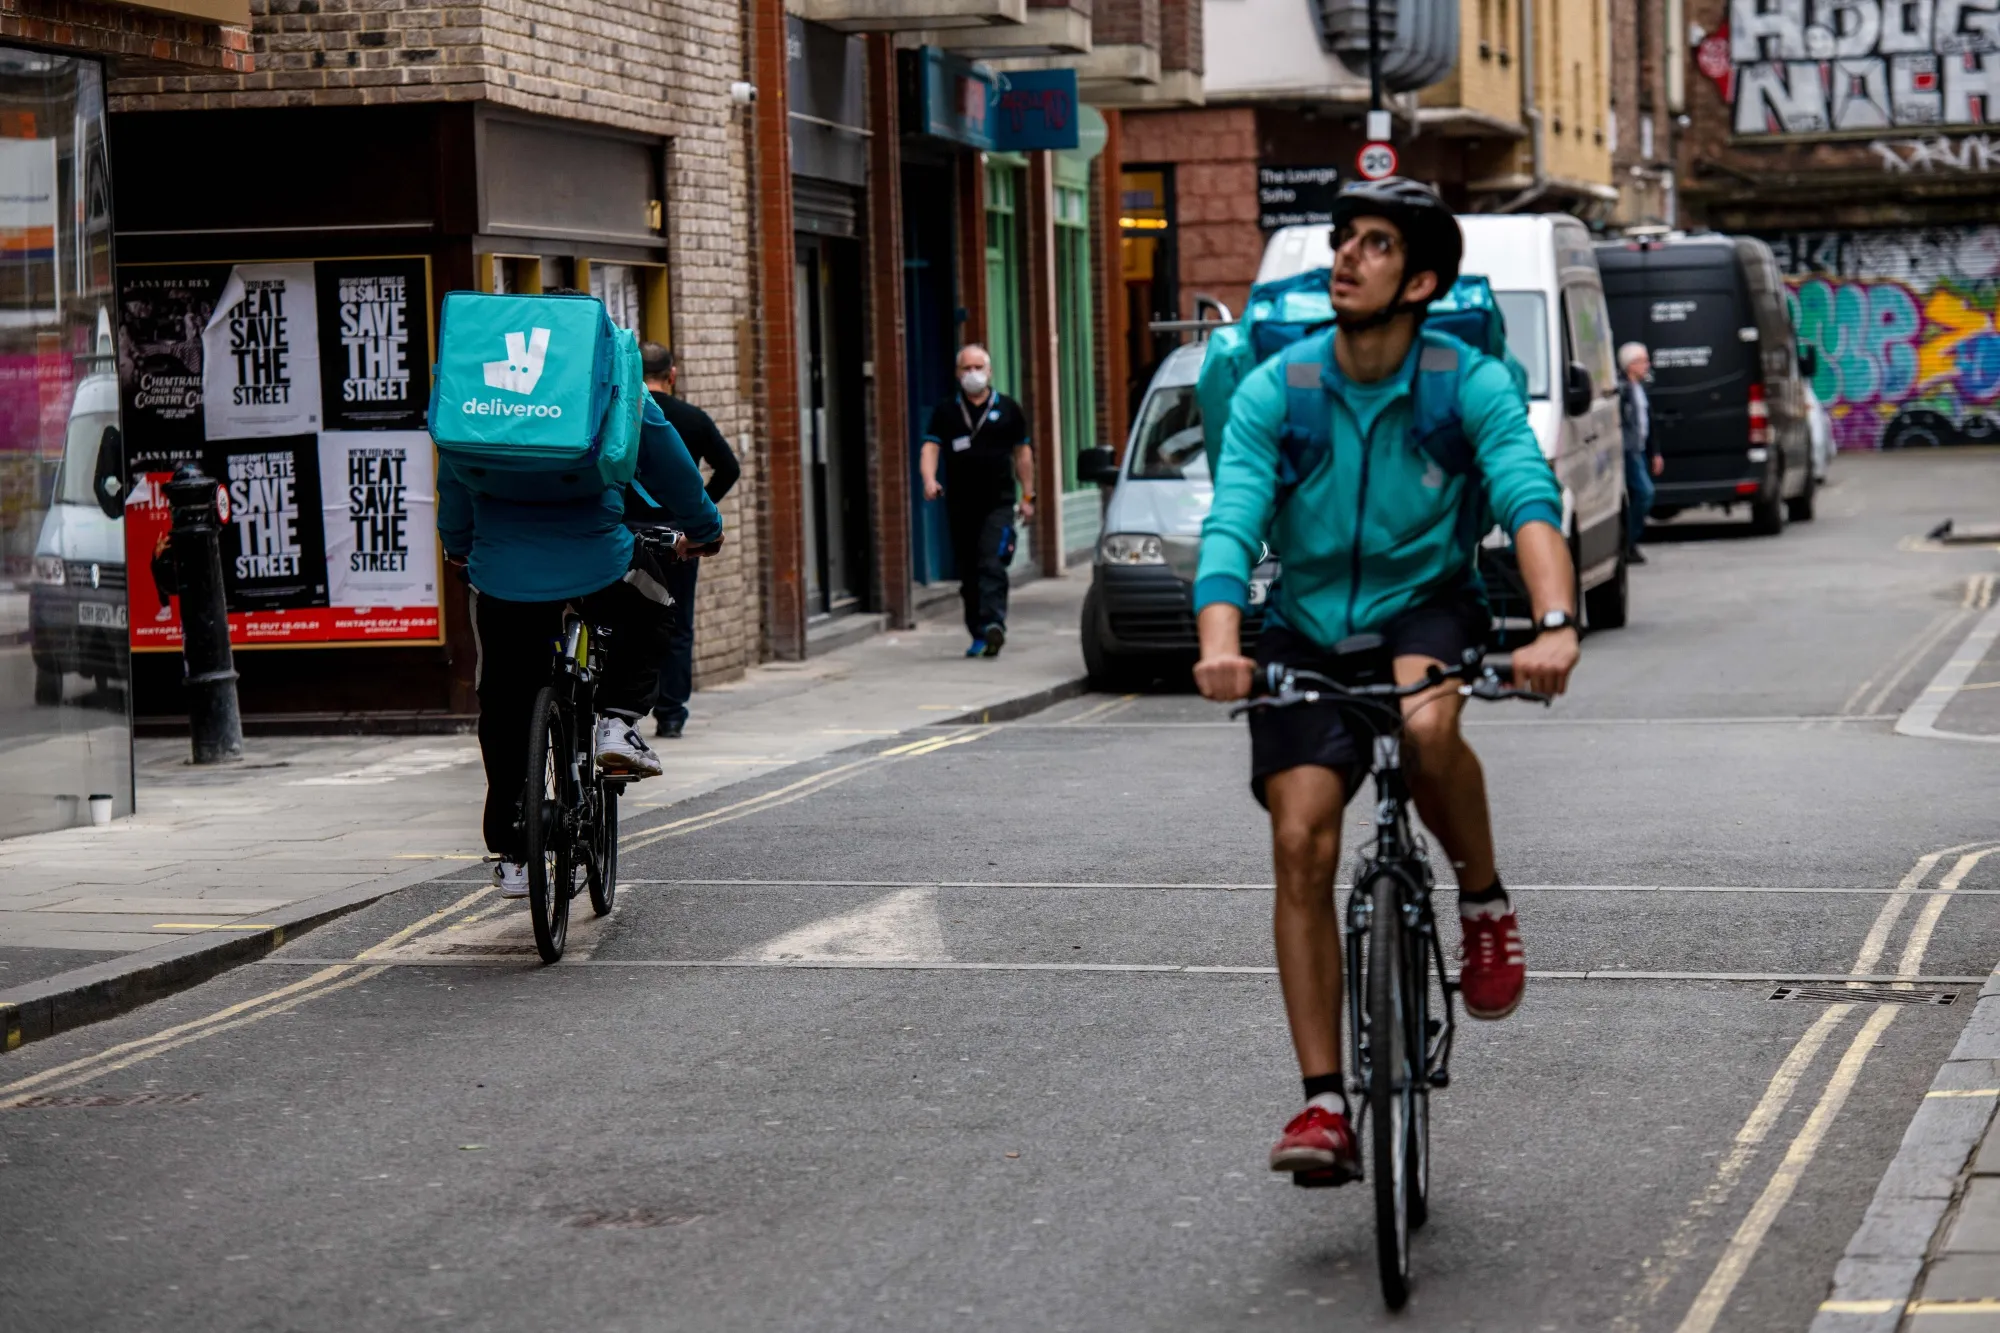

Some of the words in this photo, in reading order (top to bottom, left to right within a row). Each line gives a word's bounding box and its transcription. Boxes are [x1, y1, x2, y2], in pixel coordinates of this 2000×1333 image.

[1364, 153, 1391, 170] 20
[1260, 168, 1284, 185] The
[1286, 168, 1337, 186] Lounge
[1260, 187, 1297, 204] Soho
[339, 286, 406, 302] OBSOLETE
[340, 302, 408, 337] SAVE
[230, 317, 288, 348] SAVE
[231, 348, 290, 386] THE
[341, 336, 410, 379] THE
[140, 374, 203, 391] CHEMTRAIL
[343, 378, 410, 402] STREET
[233, 385, 290, 406] STREET
[462, 397, 562, 418] deliveroo
[228, 461, 296, 481] OBSOLETE
[348, 457, 406, 485] HEAT
[230, 477, 299, 516] SAVE
[349, 486, 407, 515] SAVE
[232, 511, 302, 556] THE
[350, 516, 408, 552] THE
[236, 554, 302, 579] STREET
[350, 552, 407, 572] STREET
